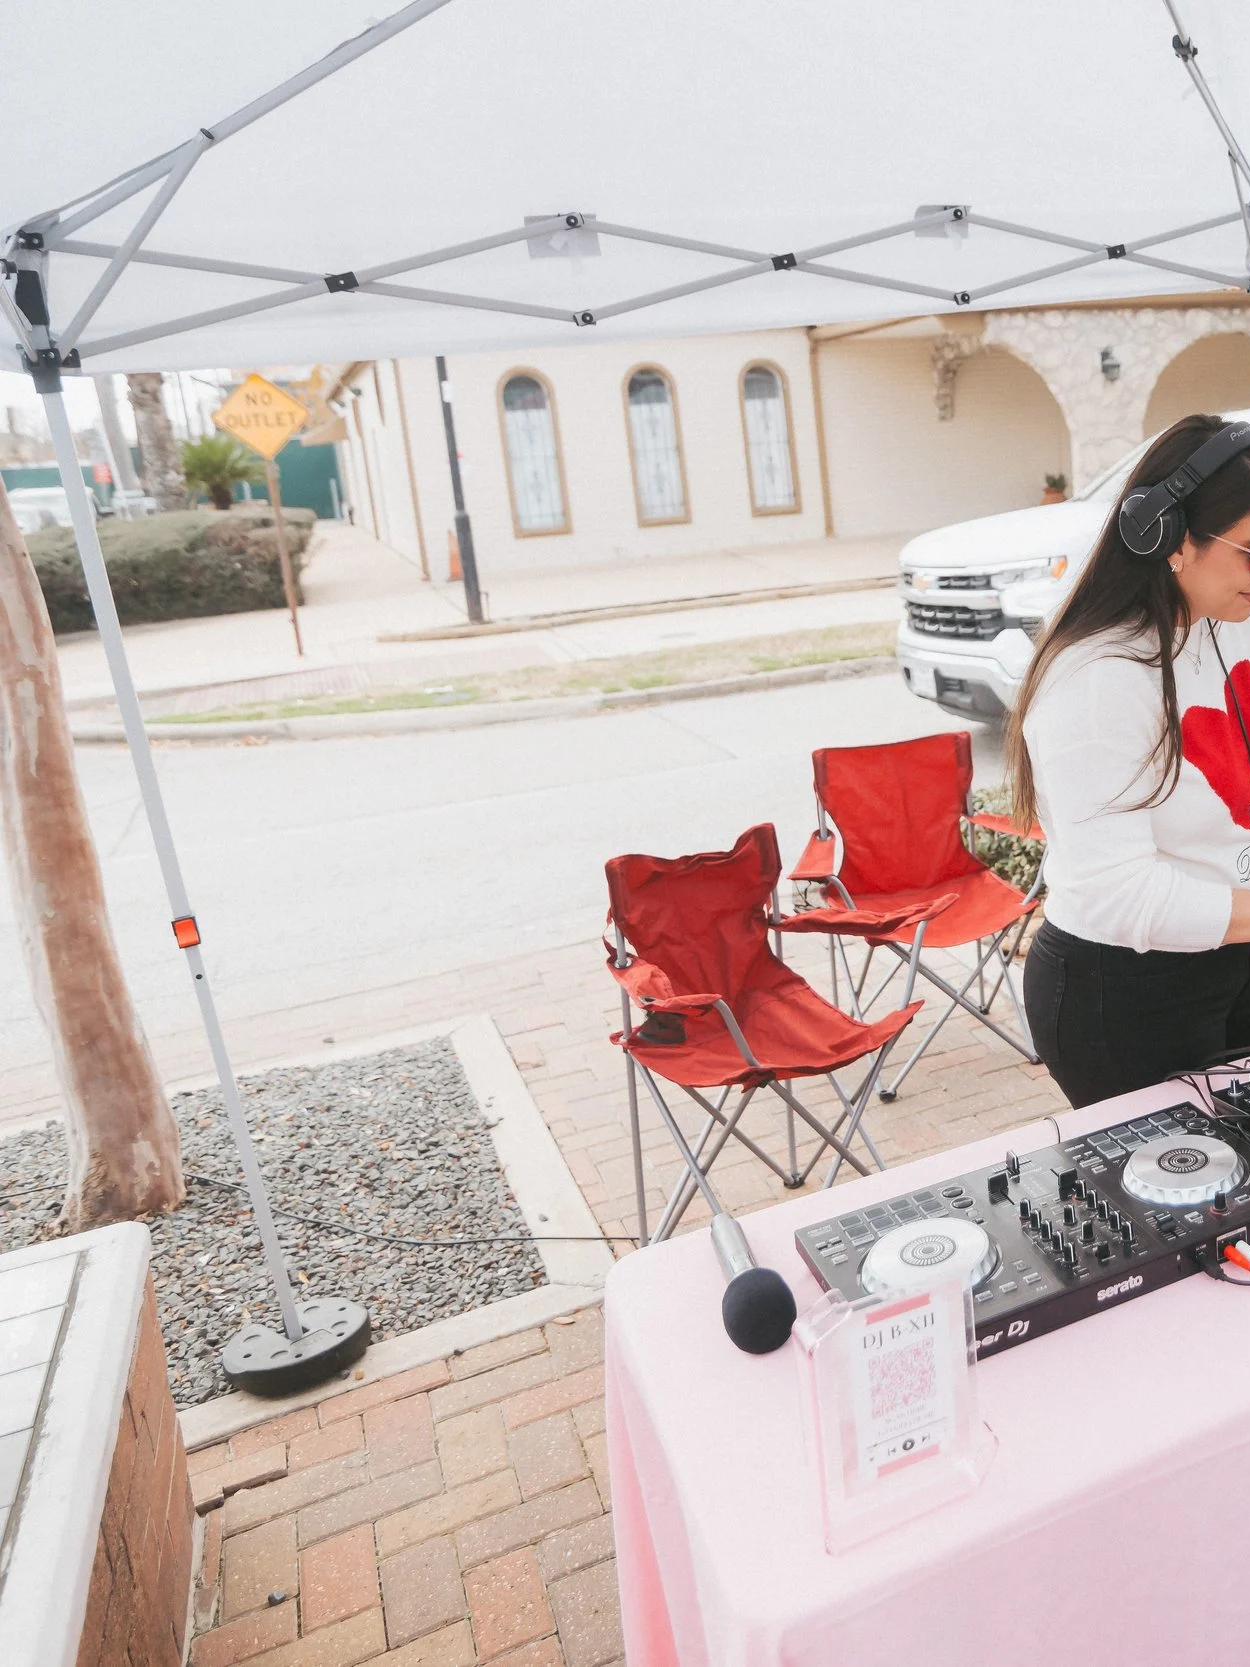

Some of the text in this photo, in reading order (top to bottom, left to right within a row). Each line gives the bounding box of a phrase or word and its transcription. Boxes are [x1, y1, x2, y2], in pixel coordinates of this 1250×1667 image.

[245, 391, 272, 406] NO
[225, 411, 296, 428] OUTLET
[1096, 1274, 1143, 1301] serato
[863, 1330, 883, 1349] DJ
